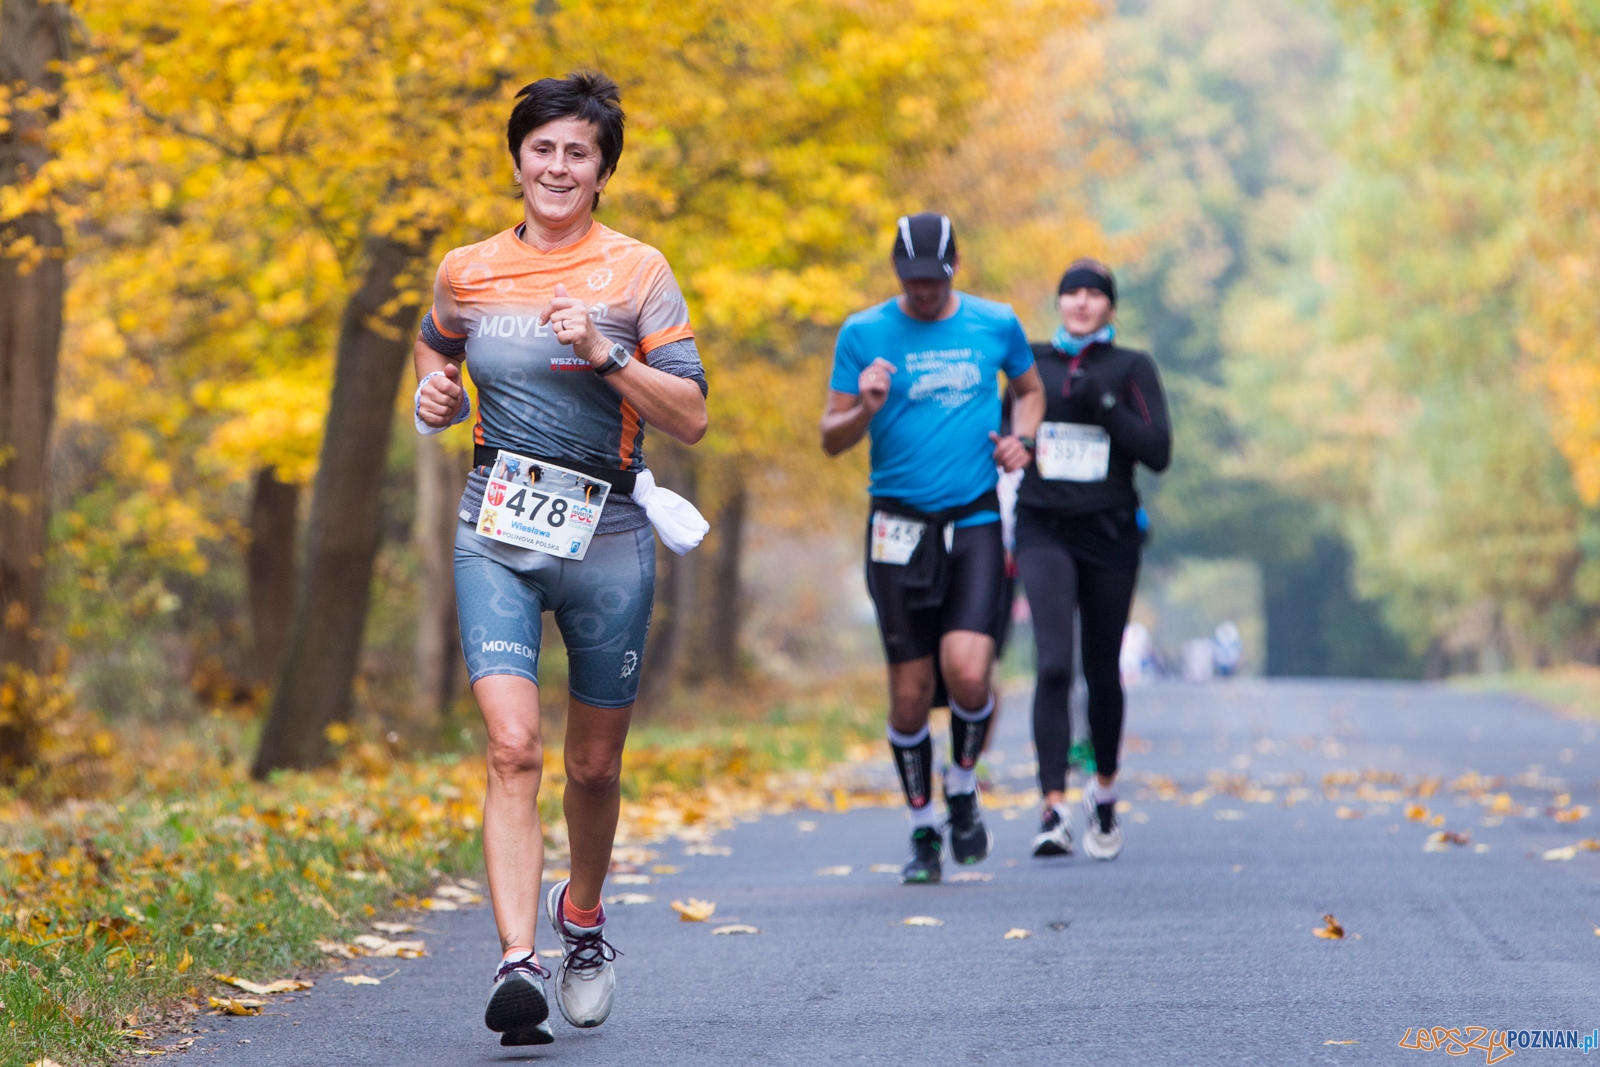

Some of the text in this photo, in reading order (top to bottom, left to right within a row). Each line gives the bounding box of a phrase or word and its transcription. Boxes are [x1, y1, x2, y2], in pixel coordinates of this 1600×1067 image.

[477, 315, 549, 338] MOVE
[505, 488, 568, 527] 478
[511, 520, 551, 538] Wiesława
[502, 531, 534, 545] POLINOVA
[535, 540, 560, 551] POLSKA
[481, 640, 522, 655] MOVE
